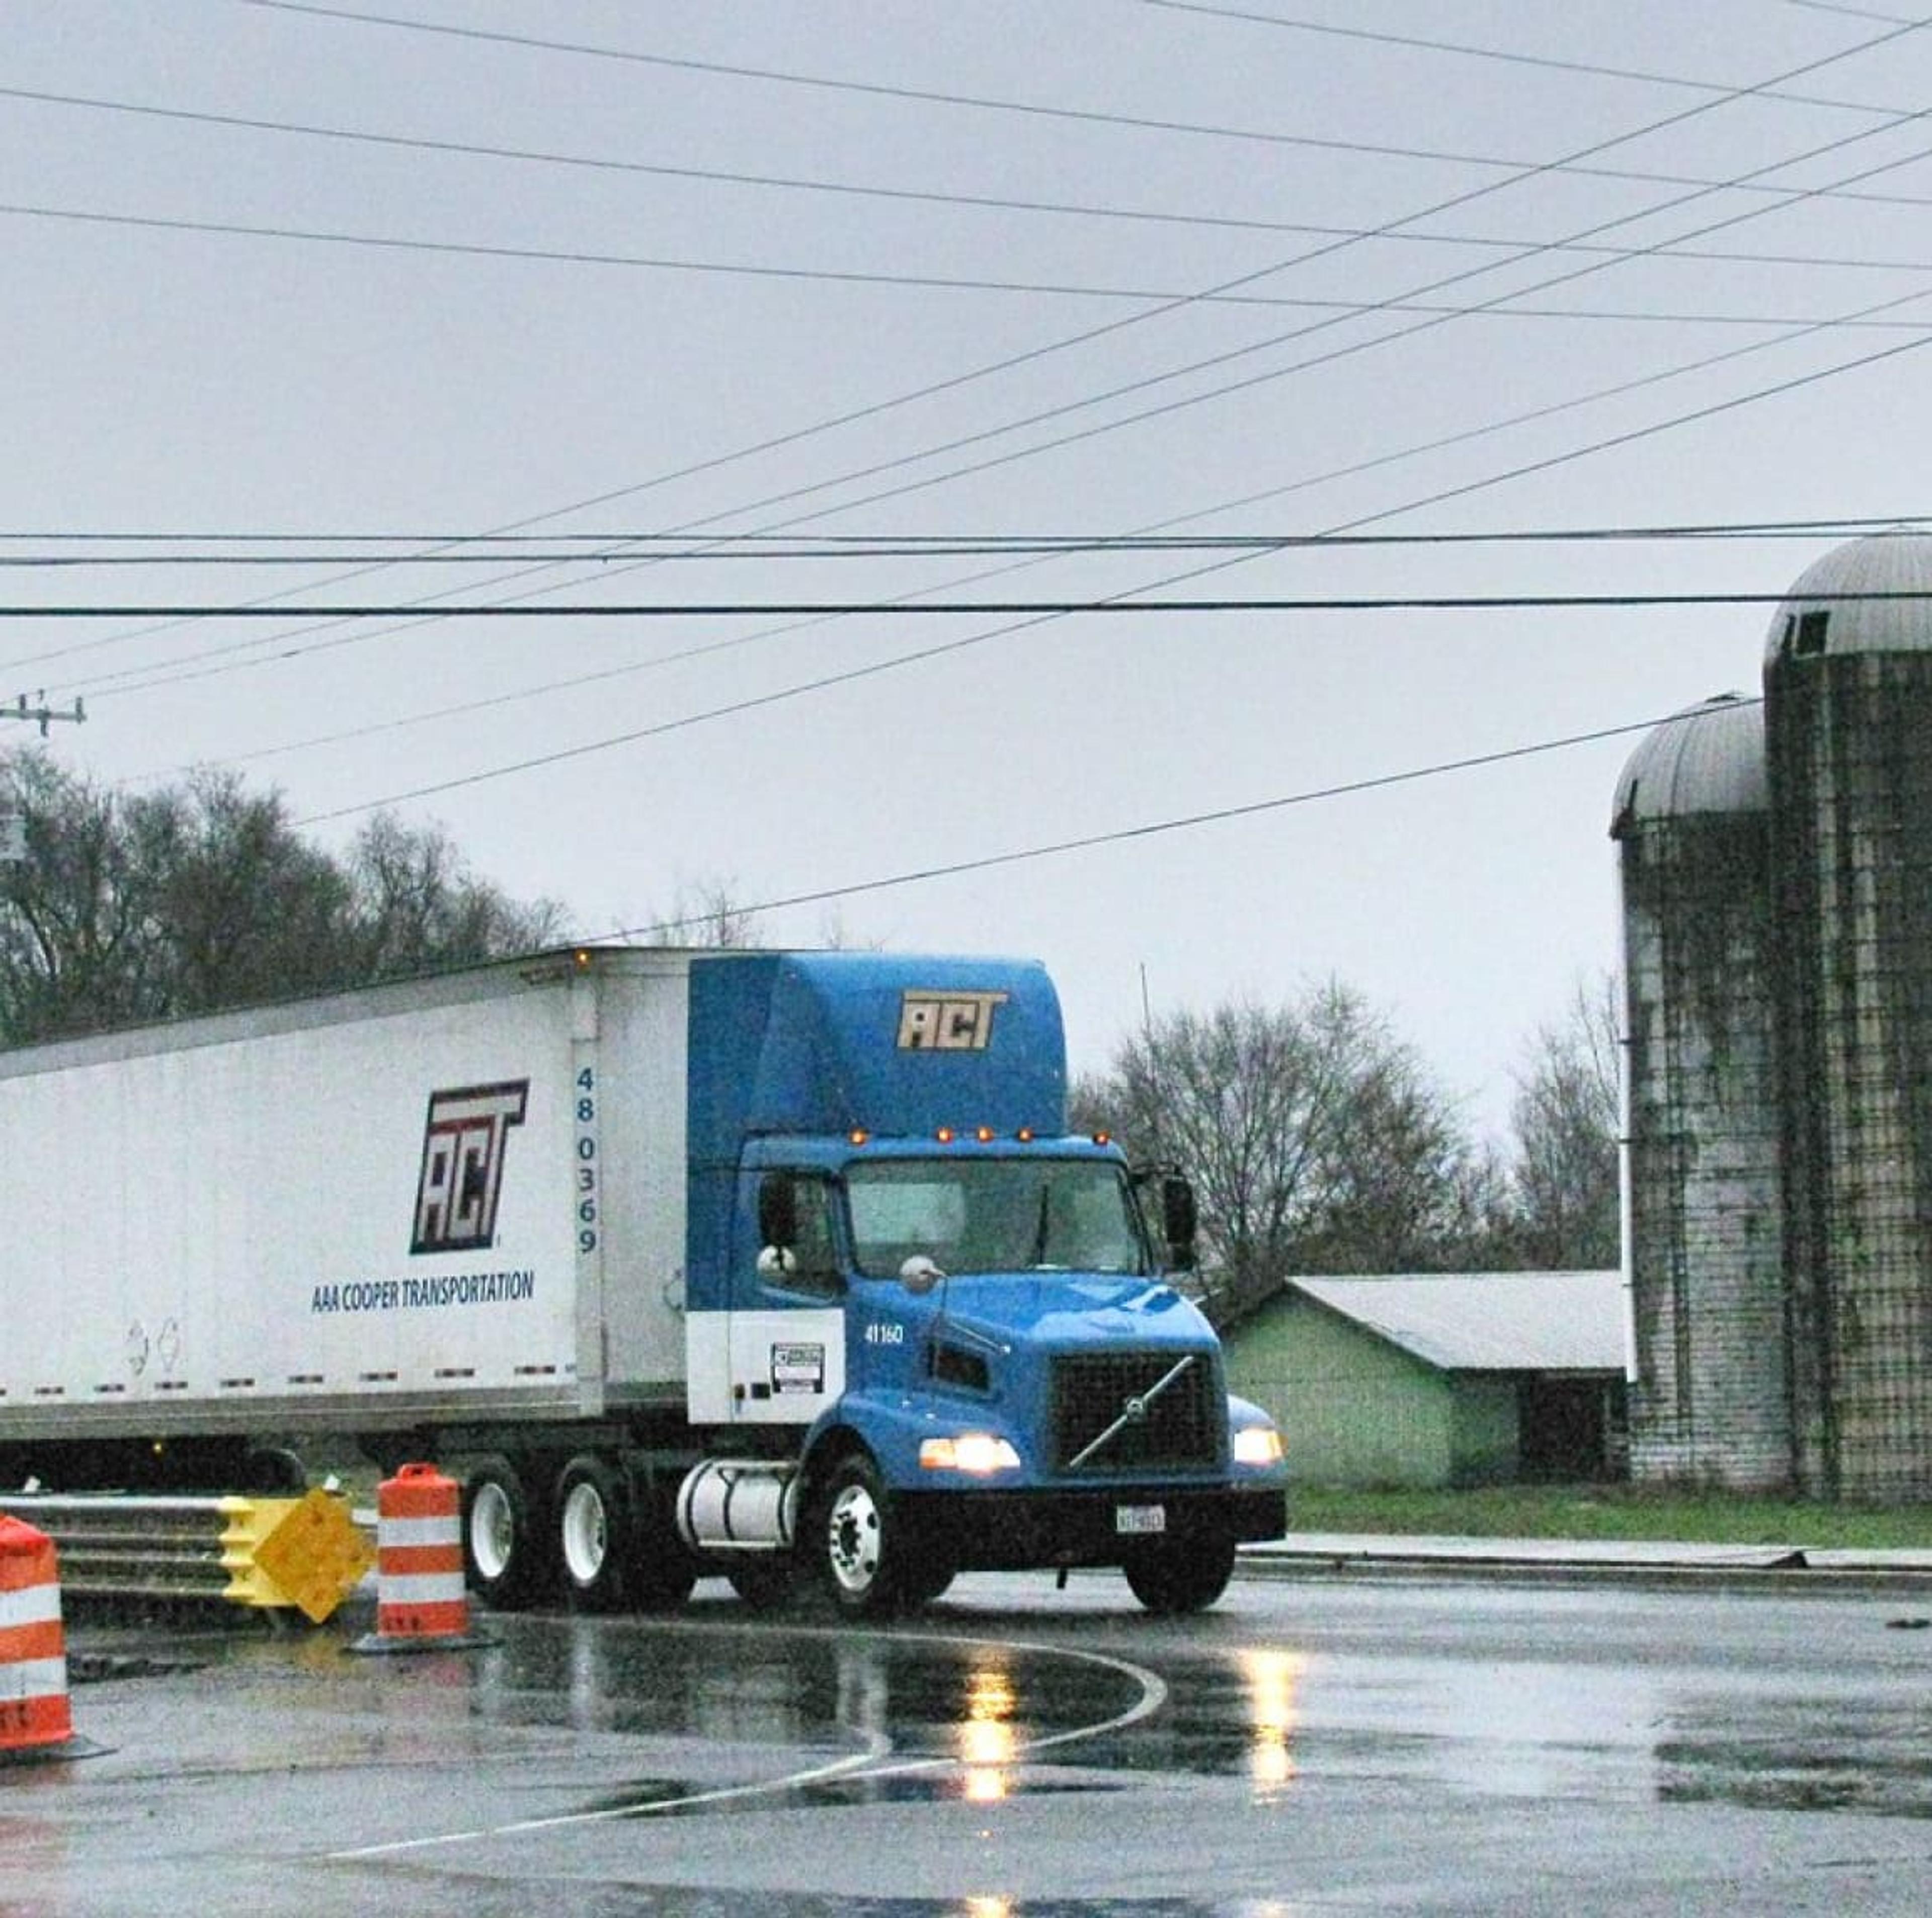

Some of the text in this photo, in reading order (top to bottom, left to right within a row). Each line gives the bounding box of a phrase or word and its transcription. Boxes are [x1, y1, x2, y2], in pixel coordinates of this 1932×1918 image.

[312, 1270, 534, 1312] AAA COOPER TRANSPORTATION
[864, 1322, 903, 1344] 41160
